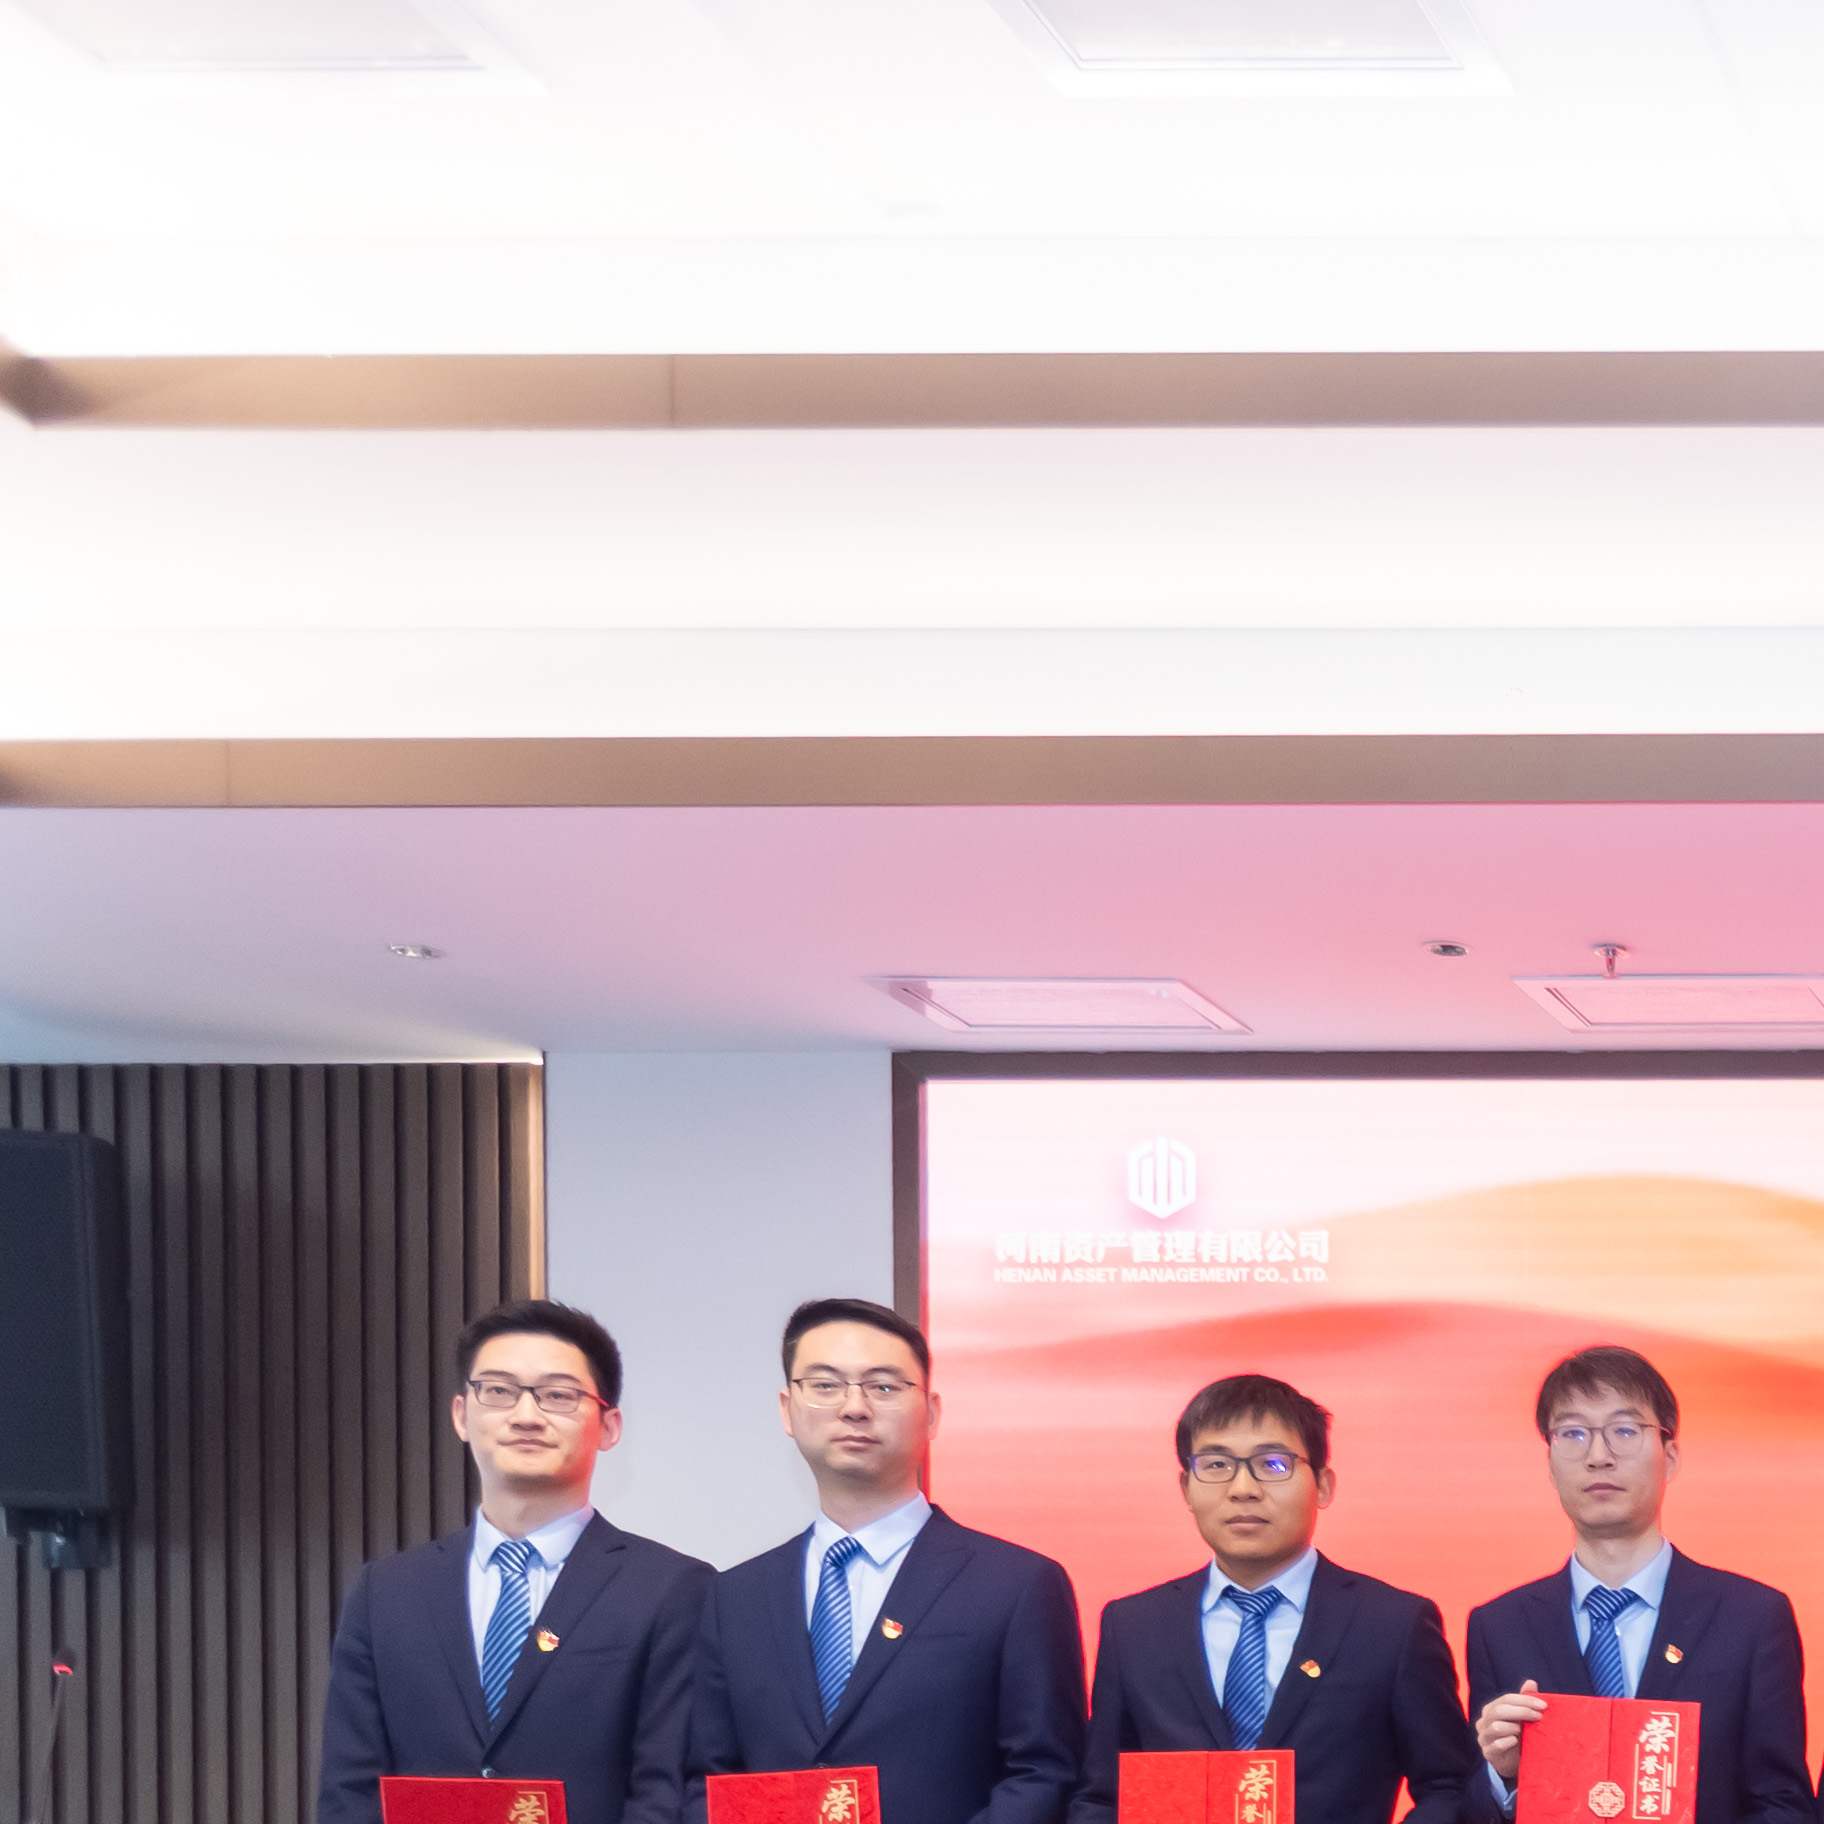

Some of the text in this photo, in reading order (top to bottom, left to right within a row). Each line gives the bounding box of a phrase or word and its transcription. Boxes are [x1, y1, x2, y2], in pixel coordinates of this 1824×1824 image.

[995, 1229, 1329, 1264] 河南资产管理有限公司
[994, 1267, 1329, 1284] HENAN ASSET MANAGEMENT CO., LTD.
[1639, 1716, 1676, 1814] 荣誉证书
